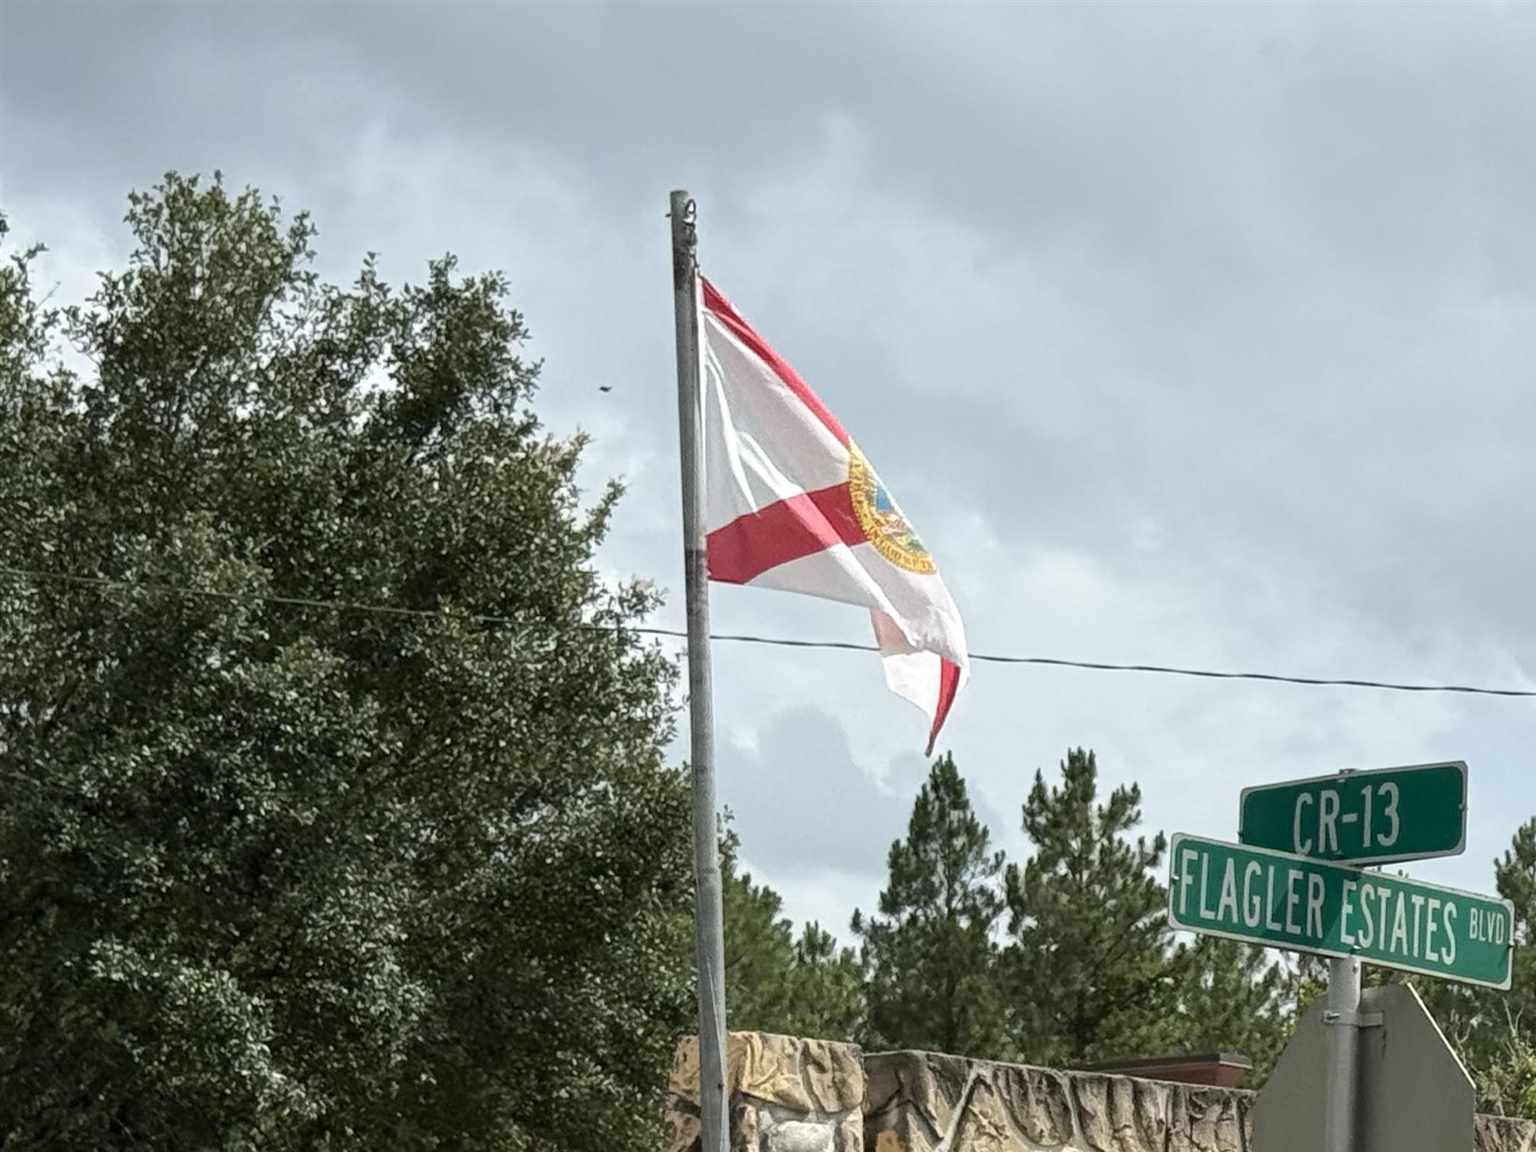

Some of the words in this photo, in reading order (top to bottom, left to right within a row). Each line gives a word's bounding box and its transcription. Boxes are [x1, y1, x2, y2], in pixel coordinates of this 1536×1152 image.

[1293, 781, 1400, 855] CR-13
[1178, 850, 1325, 939] FLAGLER
[1339, 881, 1457, 966] ESTATES
[1469, 907, 1504, 945] BLVD
